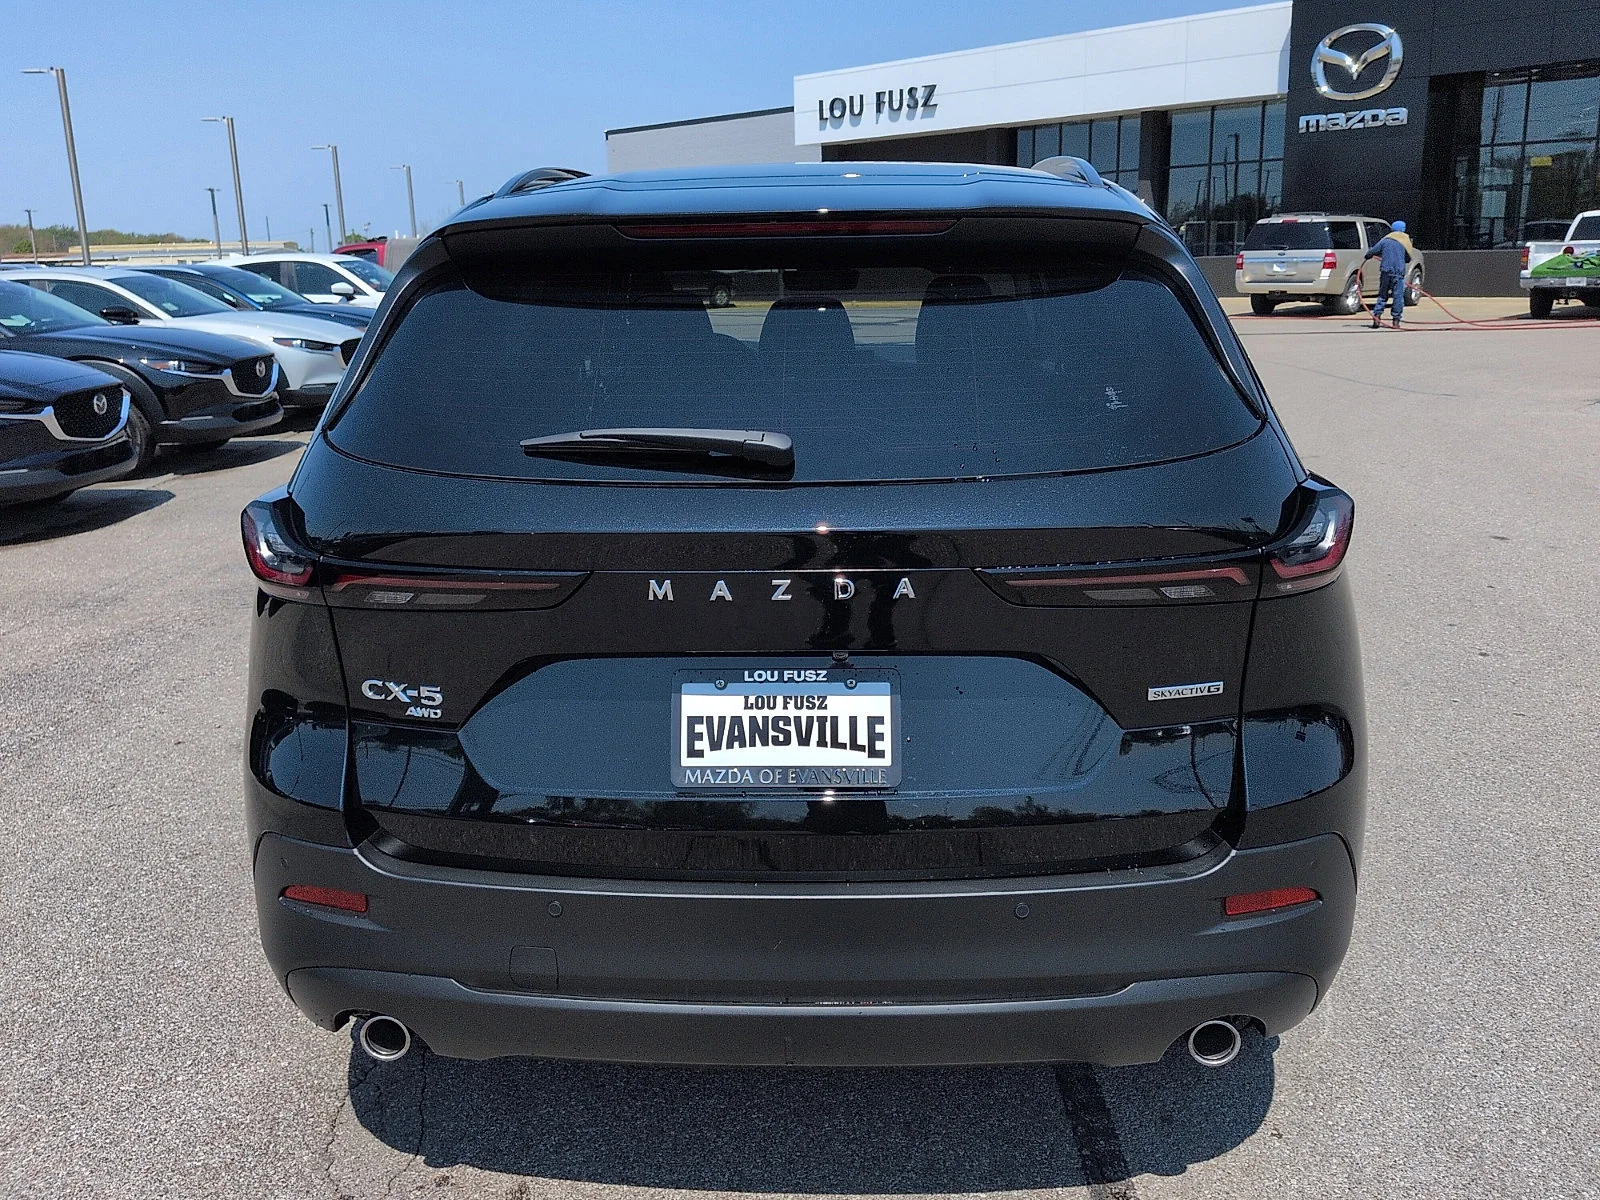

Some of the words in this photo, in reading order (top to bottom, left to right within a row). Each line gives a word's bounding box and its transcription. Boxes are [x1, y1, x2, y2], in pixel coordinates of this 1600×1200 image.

[818, 94, 864, 120] LOU
[875, 84, 938, 114] FUSZ
[648, 577, 917, 601] MAZDA
[744, 670, 779, 682] LOU
[783, 670, 828, 682] FUSZ
[361, 679, 443, 706] CX-5
[743, 695, 777, 710] LOU
[782, 695, 828, 710] FUSZ
[405, 706, 442, 719] AWD
[686, 715, 886, 759] EVANSVILLE
[684, 768, 754, 784] MAZDA
[760, 768, 783, 784] OF
[787, 768, 887, 784] EVANSVILLE
